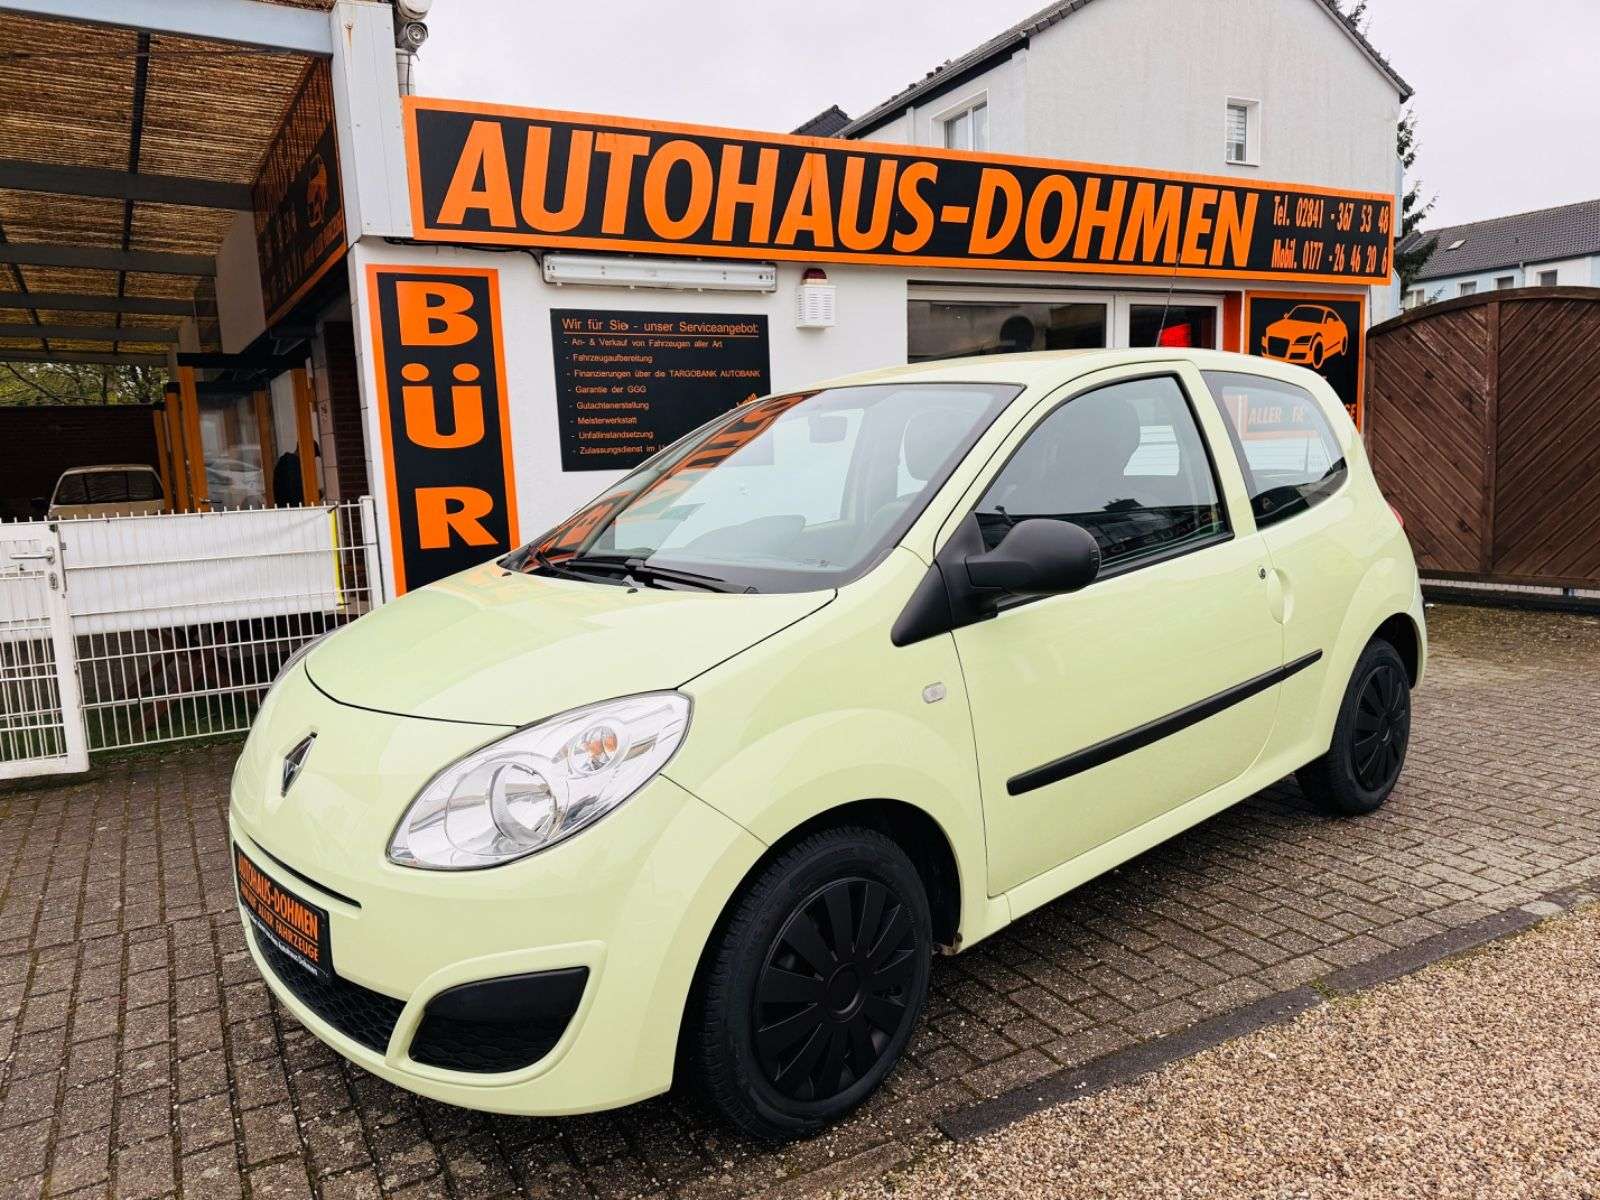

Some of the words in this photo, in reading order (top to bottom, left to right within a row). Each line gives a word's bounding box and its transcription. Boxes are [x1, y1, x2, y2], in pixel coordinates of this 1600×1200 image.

[436, 120, 1259, 268] AUTOHAUS-DOHMEN
[1273, 195, 1290, 226] Tel.
[1295, 198, 1324, 229] 02841
[1337, 202, 1354, 231] 367
[1360, 204, 1372, 232] 53
[1271, 238, 1297, 269] Mobil.
[1302, 240, 1324, 270] 0177
[1333, 242, 1345, 272] 26
[1350, 245, 1361, 273] 46
[1366, 245, 1377, 273] 20
[562, 318, 581, 329] Wir
[588, 319, 603, 330] für
[643, 321, 674, 332] unser
[680, 321, 759, 335] Serviceangebot:
[572, 338, 586, 346] An-
[600, 339, 628, 347] Verkauf
[649, 339, 691, 349] Fahrzeugen
[694, 340, 708, 348] aller
[712, 340, 723, 348] Art
[573, 353, 653, 364] Fahrzeugaufbereitung
[574, 370, 631, 379] Finanzierungen
[635, 369, 651, 378] über
[670, 369, 717, 378] TARGOBANK
[720, 369, 761, 378] AUTOBANK
[575, 385, 608, 394] Garantie
[611, 385, 624, 393] der
[627, 385, 647, 394] GGG
[577, 401, 650, 410] Gutachtenerstellung
[395, 280, 499, 549] BÜR
[578, 416, 638, 425] Meisterwerkstatt
[579, 431, 654, 440] Unfallinstandsetzung
[580, 445, 643, 455] Zulassungsdienst
